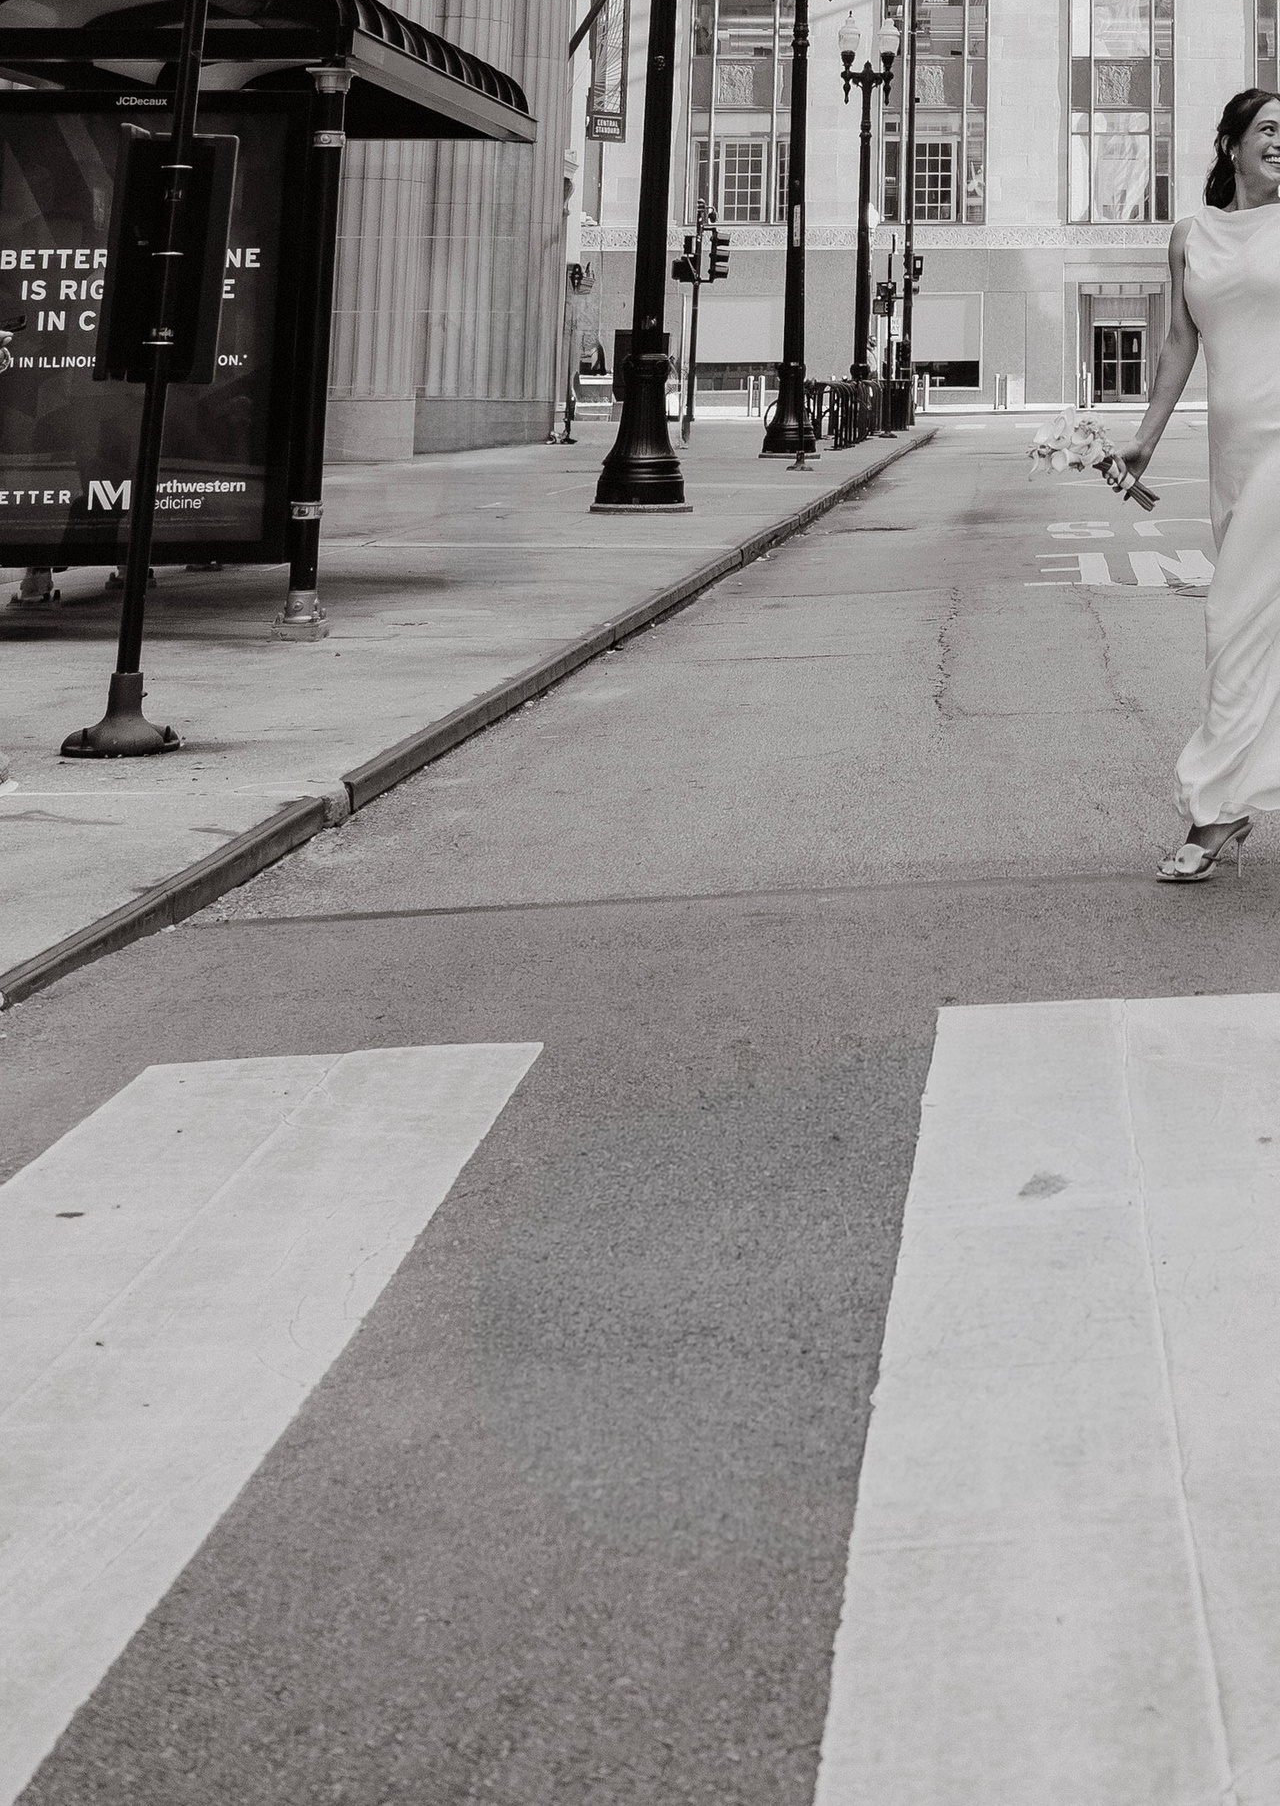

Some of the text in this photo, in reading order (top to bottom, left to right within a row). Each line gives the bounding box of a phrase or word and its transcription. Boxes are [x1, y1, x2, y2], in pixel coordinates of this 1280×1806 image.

[116, 96, 168, 106] JCDecaux
[0, 249, 108, 270] BETTER
[22, 280, 105, 300] IS RIG
[38, 311, 66, 331] IN
[20, 357, 34, 368] IN
[0, 490, 71, 504] ETTER
[156, 479, 246, 493] rthwestern
[154, 495, 202, 510] edicine
